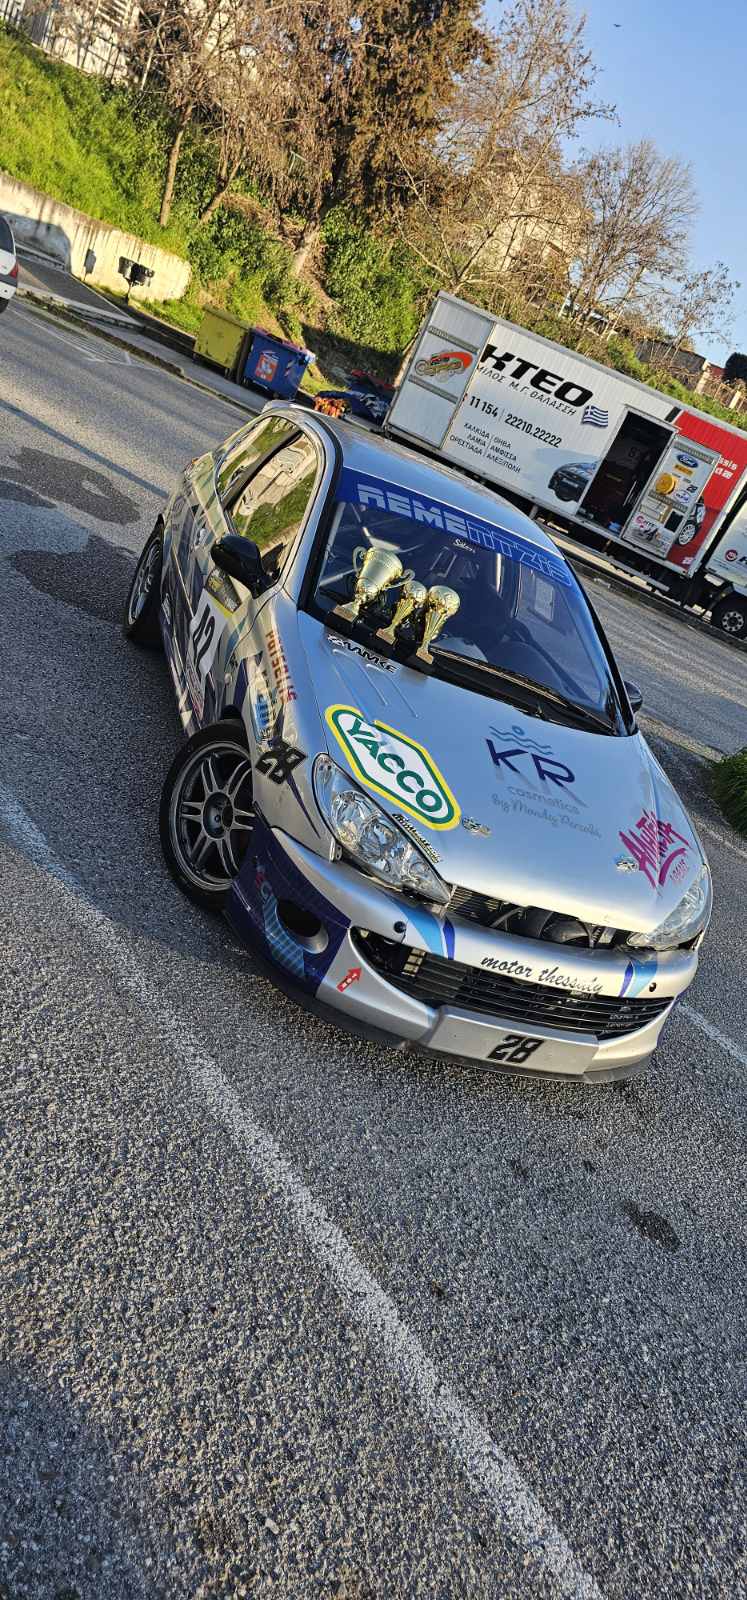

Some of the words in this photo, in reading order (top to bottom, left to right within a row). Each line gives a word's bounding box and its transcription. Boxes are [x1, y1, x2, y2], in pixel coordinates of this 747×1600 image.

[504, 413, 563, 448] 22210.22222
[678, 454, 698, 467] Ford
[255, 744, 306, 784] 28
[347, 719, 442, 812] YACCO
[485, 738, 576, 788] KR
[506, 785, 581, 816] cosmetics
[480, 957, 532, 978] motor
[487, 1034, 544, 1064] 28
